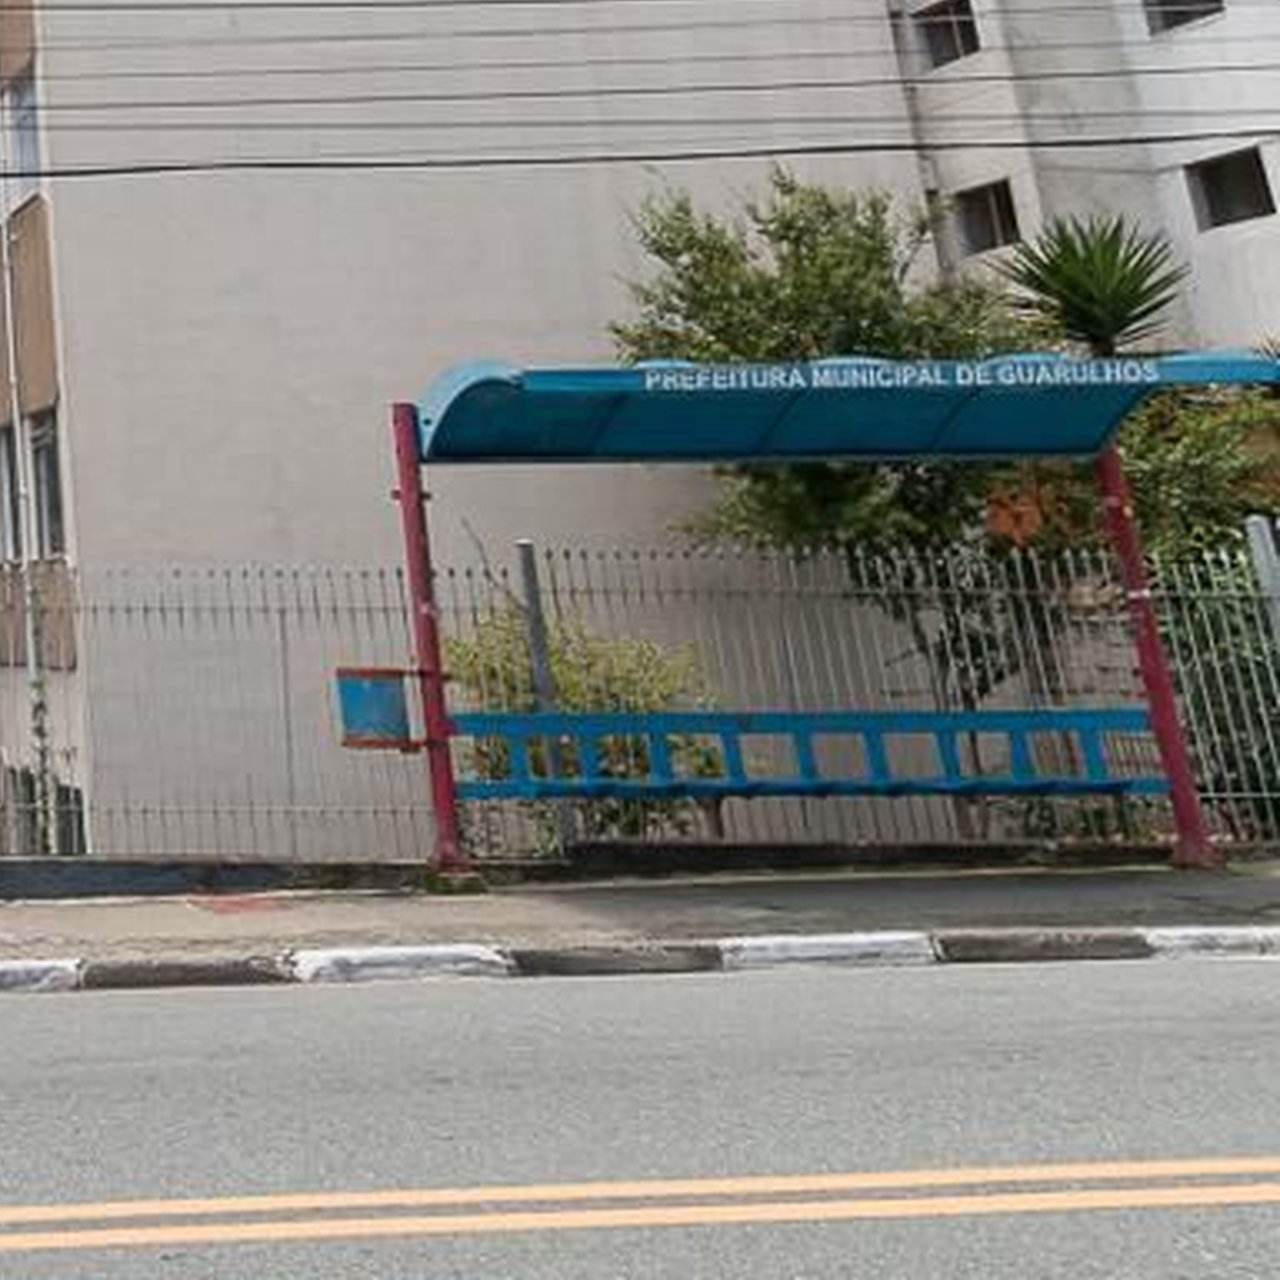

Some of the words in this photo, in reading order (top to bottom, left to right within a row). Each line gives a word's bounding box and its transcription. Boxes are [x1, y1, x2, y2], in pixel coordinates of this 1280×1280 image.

[645, 369, 807, 390] PREFEITURA
[812, 365, 948, 388] MUNICIPAL
[956, 363, 991, 385] DE
[998, 360, 1160, 385] GUARULHOS
